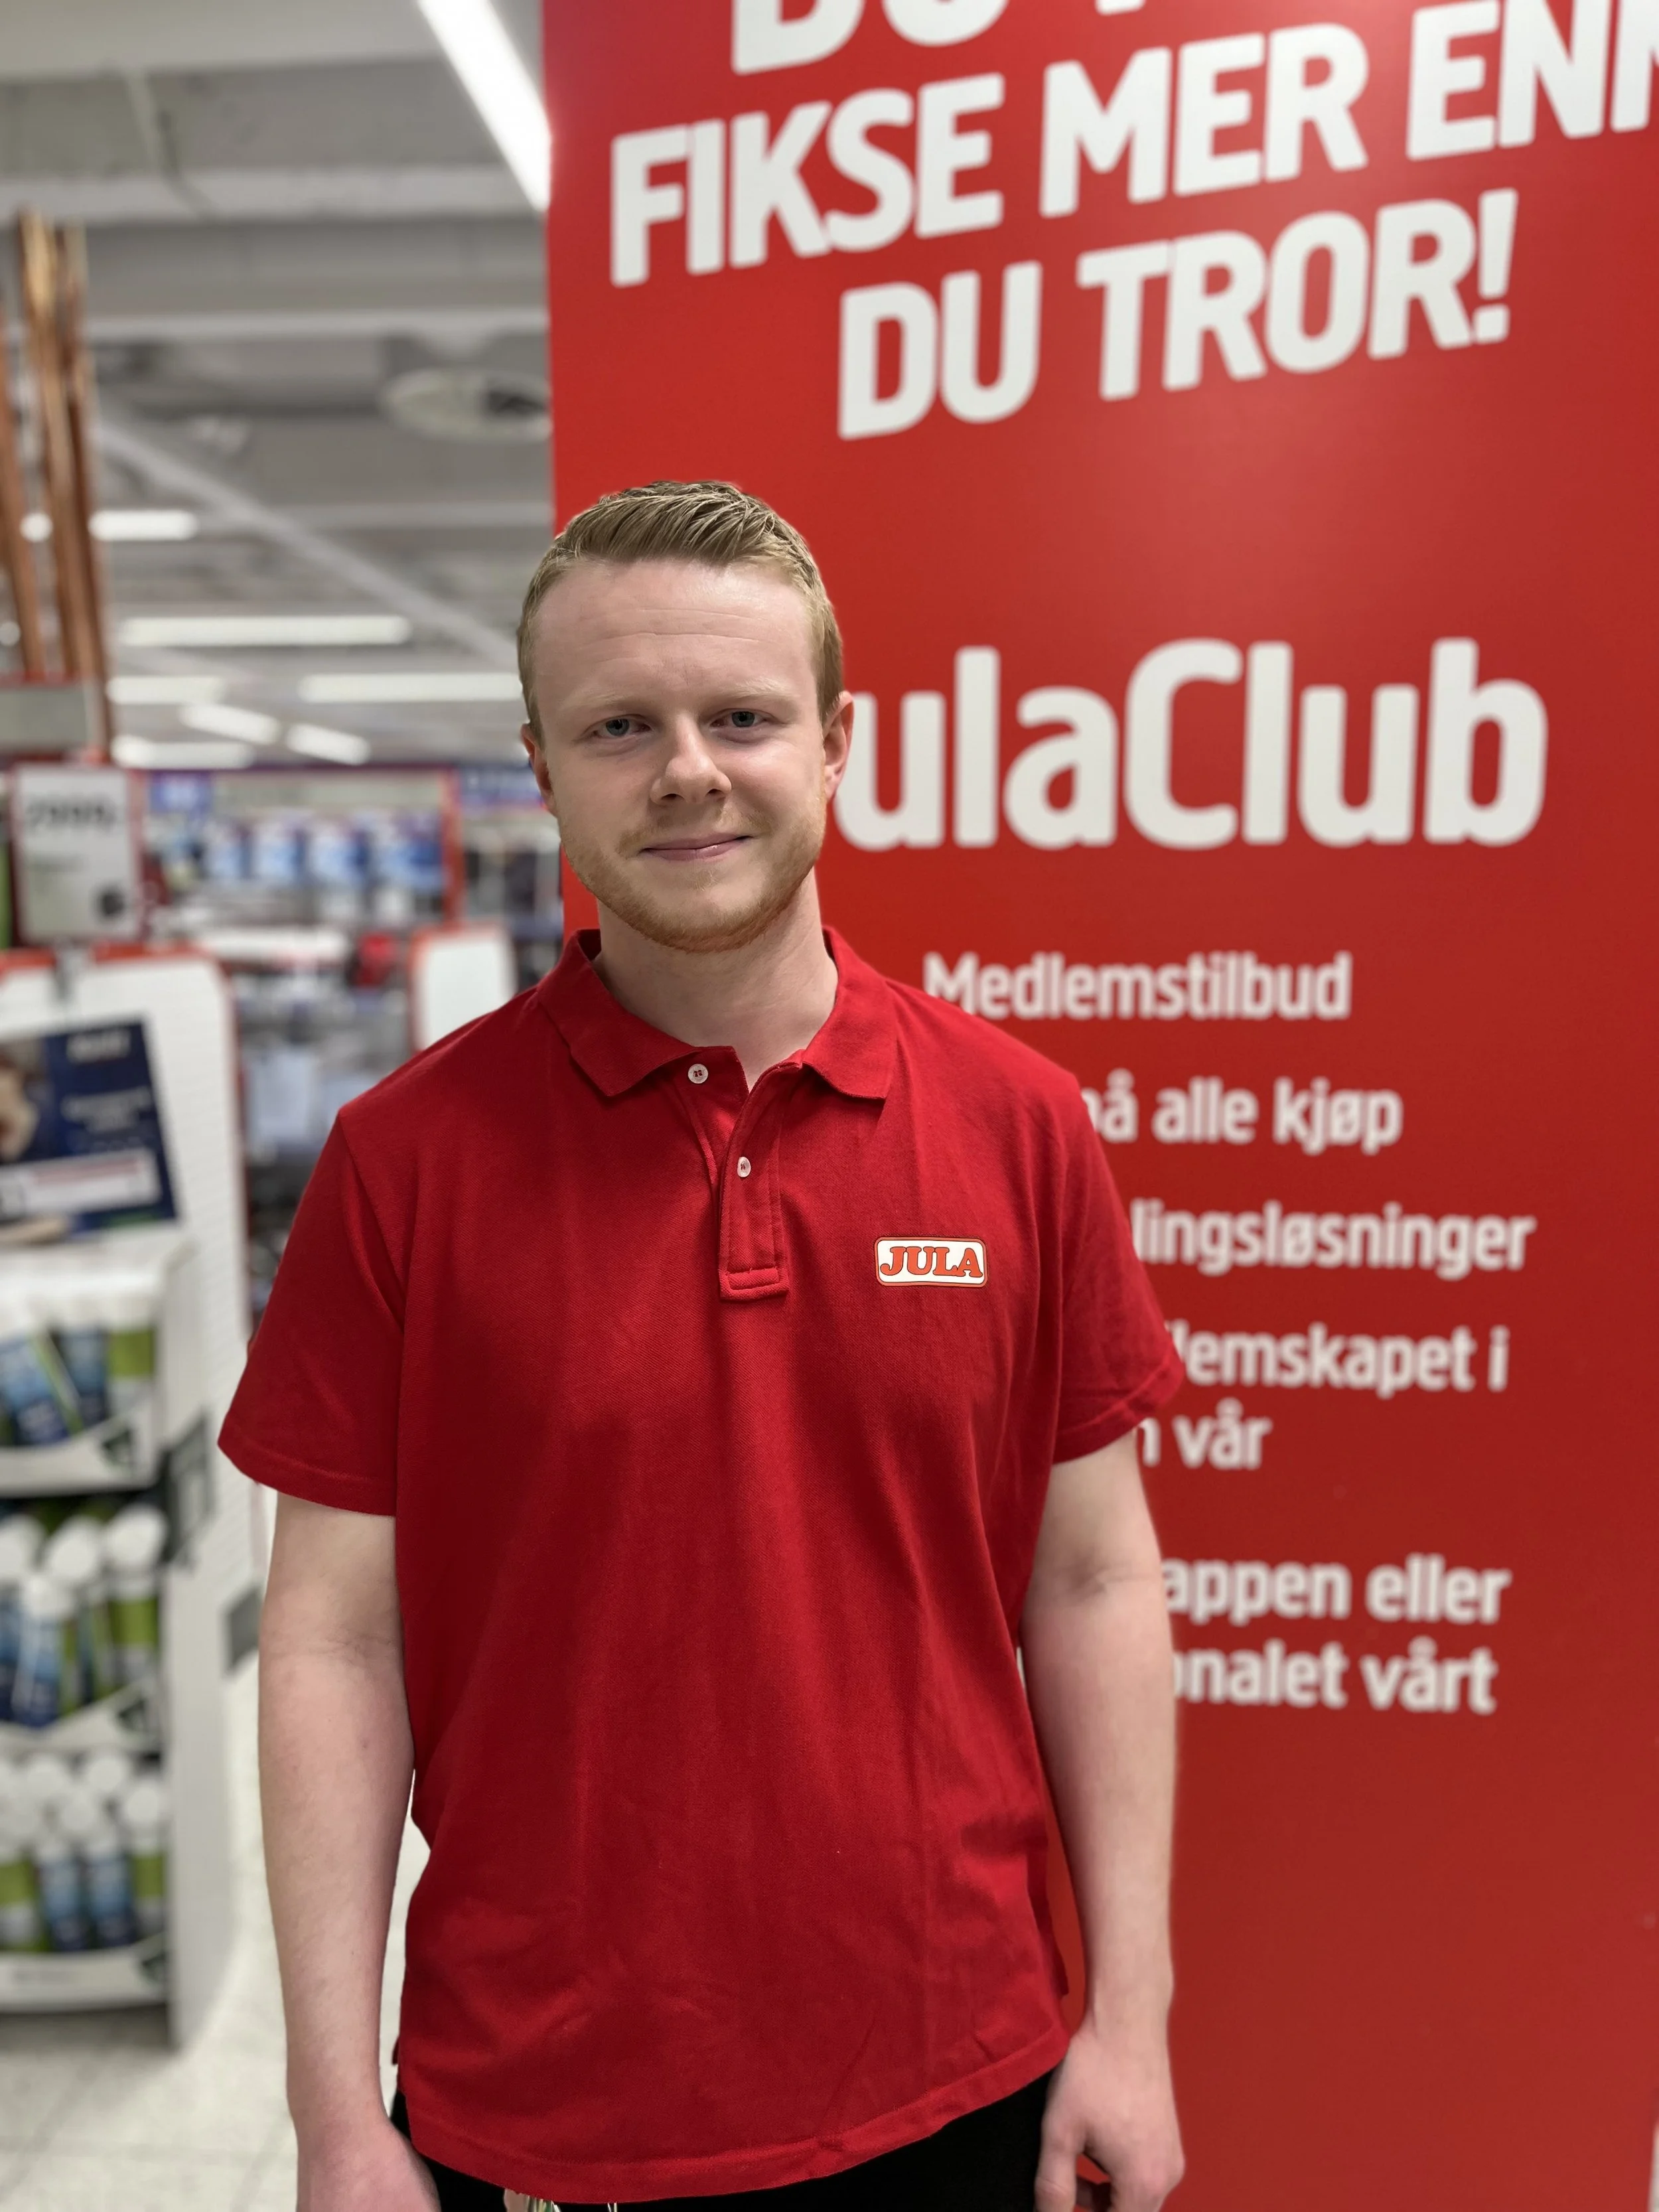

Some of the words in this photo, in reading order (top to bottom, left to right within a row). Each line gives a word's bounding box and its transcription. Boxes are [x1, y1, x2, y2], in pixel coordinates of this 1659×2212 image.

[611, 73, 1006, 287] FIKSE
[1039, 19, 1370, 218] MER
[838, 261, 1043, 439] DU
[1076, 188, 1518, 401] TROR!
[923, 951, 1352, 1021] Medlemstilbud
[1152, 1076, 1259, 1144] alle
[1273, 1076, 1403, 1155] kjøp
[880, 1246, 983, 1278] JULA
[1488, 1325, 1509, 1391] i
[1173, 1397, 1273, 1469] vår
[1366, 1553, 1512, 1624] eller
[1360, 1636, 1498, 1715] vårt
